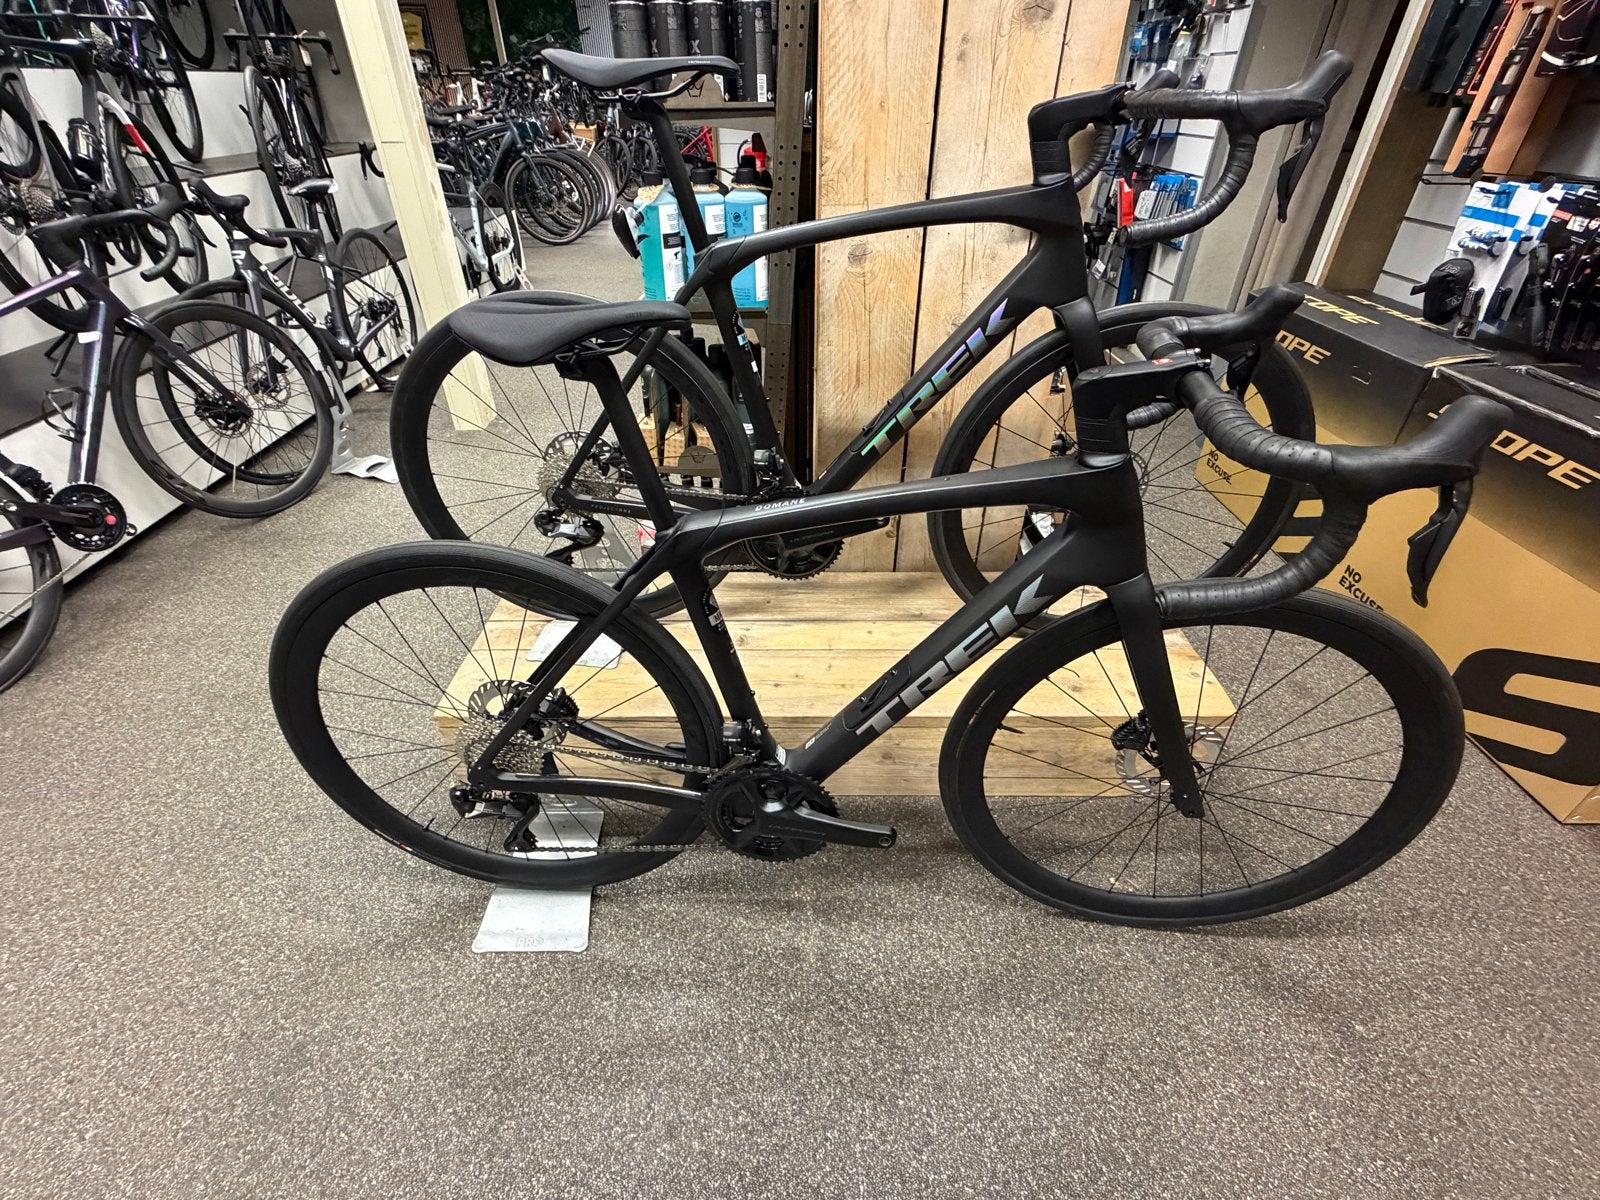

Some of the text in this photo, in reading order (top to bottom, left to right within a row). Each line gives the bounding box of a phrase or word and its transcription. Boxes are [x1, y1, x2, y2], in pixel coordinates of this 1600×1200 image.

[1274, 329, 1332, 365] OPE
[860, 297, 1016, 457] TREK
[754, 497, 807, 512] DOMANE
[1344, 564, 1362, 584] NO
[855, 573, 1054, 738] TREK
